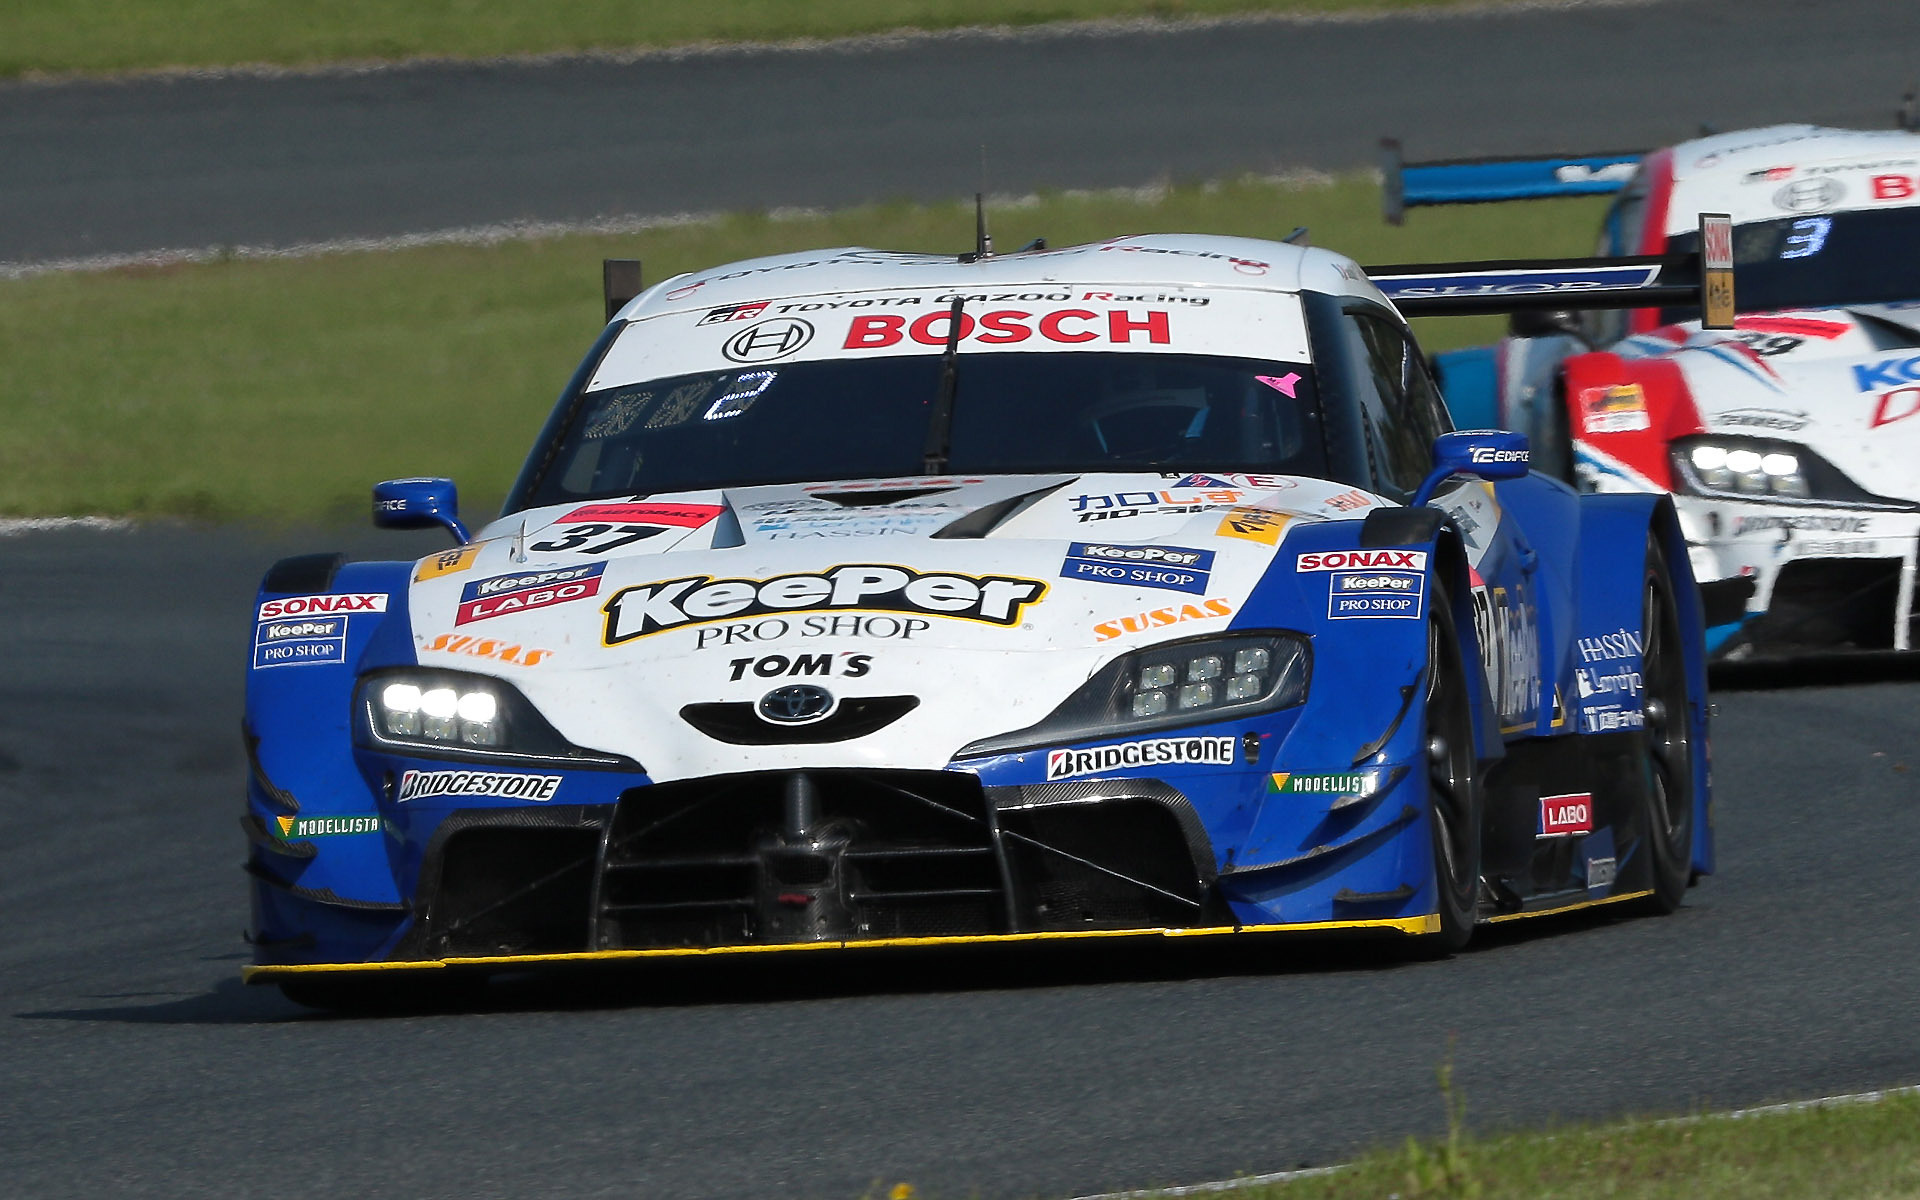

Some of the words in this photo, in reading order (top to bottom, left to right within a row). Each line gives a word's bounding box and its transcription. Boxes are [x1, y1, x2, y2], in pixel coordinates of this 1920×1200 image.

[776, 296, 922, 314] TOYOTA
[1081, 291, 1211, 307] Racing
[842, 309, 1171, 350] BOSCH
[529, 524, 671, 555] 37
[769, 527, 918, 541] HASSIN
[1083, 544, 1201, 566] KeePer
[1300, 551, 1417, 569] SONAX
[479, 567, 592, 595] KeePer
[1077, 563, 1125, 580] PRO
[1131, 569, 1195, 585] SHOP
[1342, 575, 1414, 590] KeePer
[262, 595, 379, 617] SONAX
[472, 584, 586, 617] LABO
[604, 564, 1046, 645] KeePer
[1339, 599, 1370, 611] PRO
[1370, 599, 1411, 610] SHOP
[268, 621, 337, 639] KeePer
[1093, 597, 1234, 641] SUSAS
[696, 616, 789, 651] PRO
[801, 614, 931, 641] SHOP
[265, 646, 294, 660] PRO
[295, 643, 335, 657] SHOP
[728, 651, 875, 682] TOM'S
[1050, 737, 1235, 778] BRIDGESTONE
[401, 772, 560, 801] BRIDGESTONE
[1548, 804, 1587, 826] LABO
[298, 817, 379, 836] MODELLISTA
